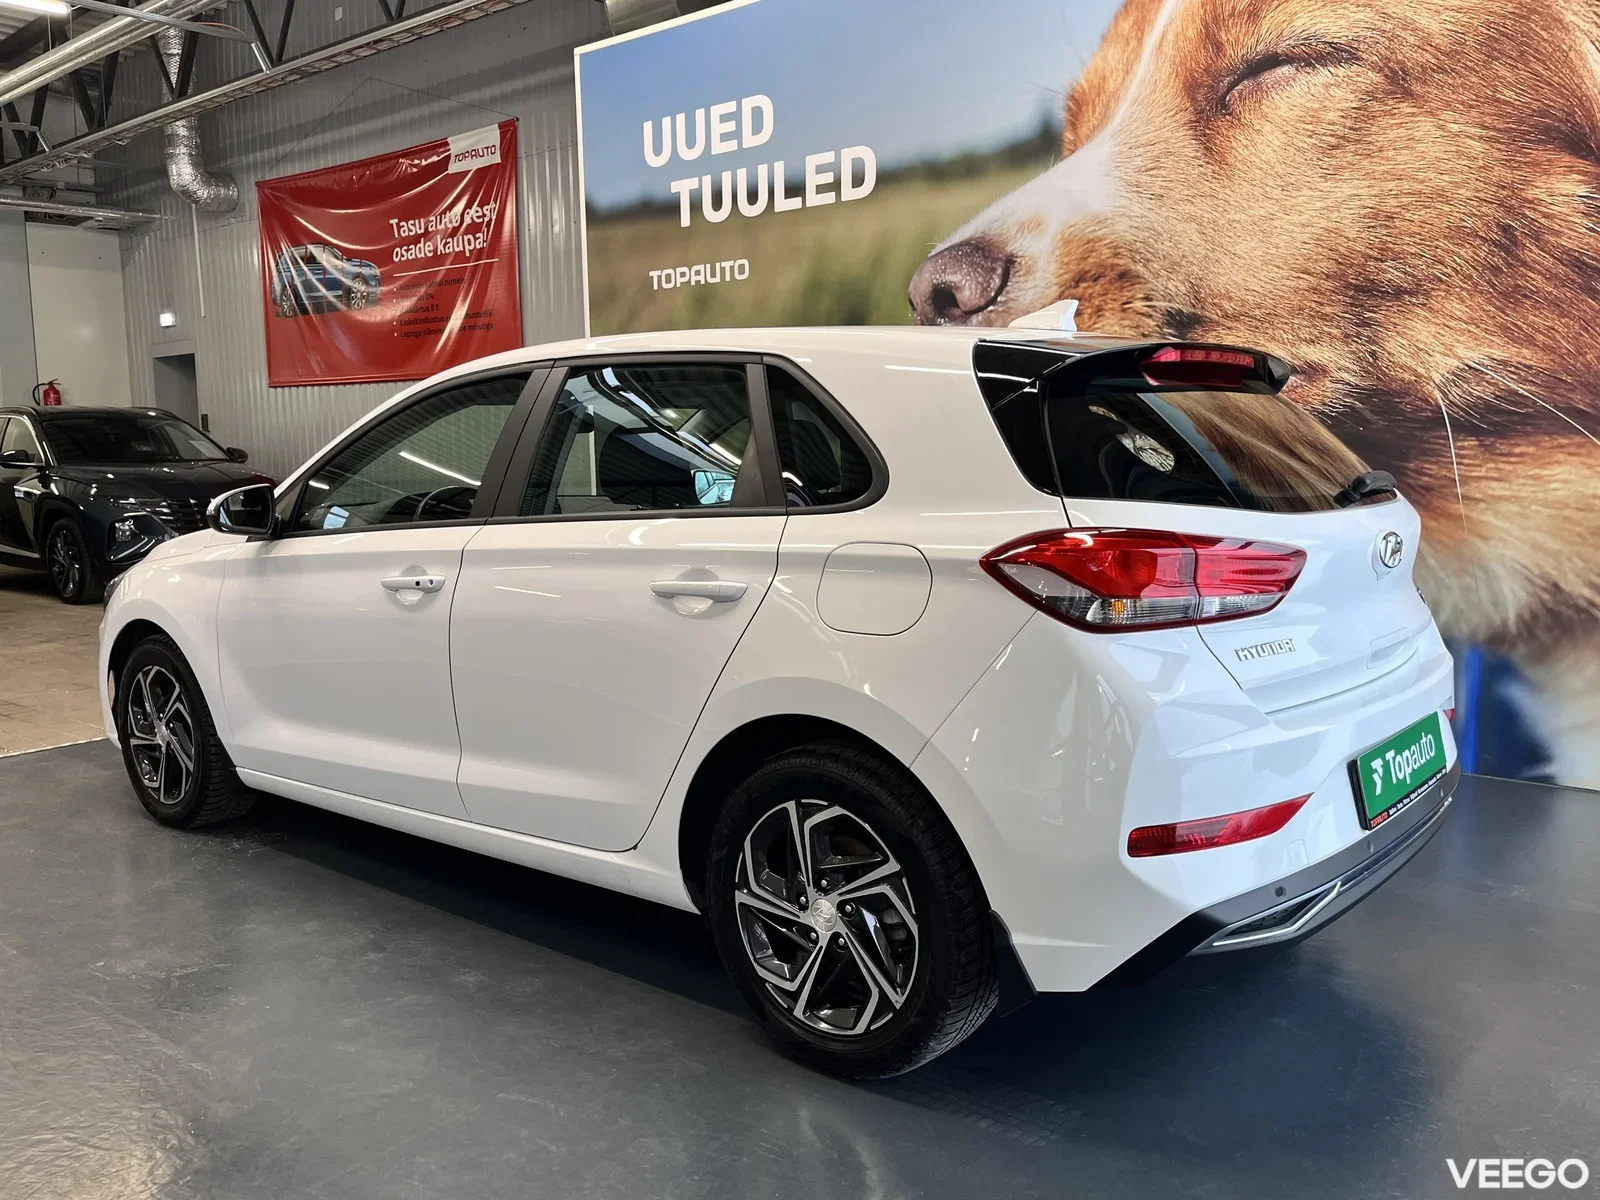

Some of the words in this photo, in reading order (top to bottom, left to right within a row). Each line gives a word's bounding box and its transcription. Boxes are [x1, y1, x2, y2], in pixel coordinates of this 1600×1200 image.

[643, 94, 774, 168] UUED
[453, 144, 497, 163] TOPAUTO
[670, 145, 877, 228] TUULED
[389, 218, 425, 238] Tasu
[428, 209, 461, 231] auto
[463, 201, 497, 224] eest
[392, 238, 434, 262] osade
[437, 227, 487, 257] kaupa!
[649, 258, 749, 290] TOPAUTO
[1234, 638, 1296, 662] HYUNDAI
[1385, 732, 1435, 785] Topauto
